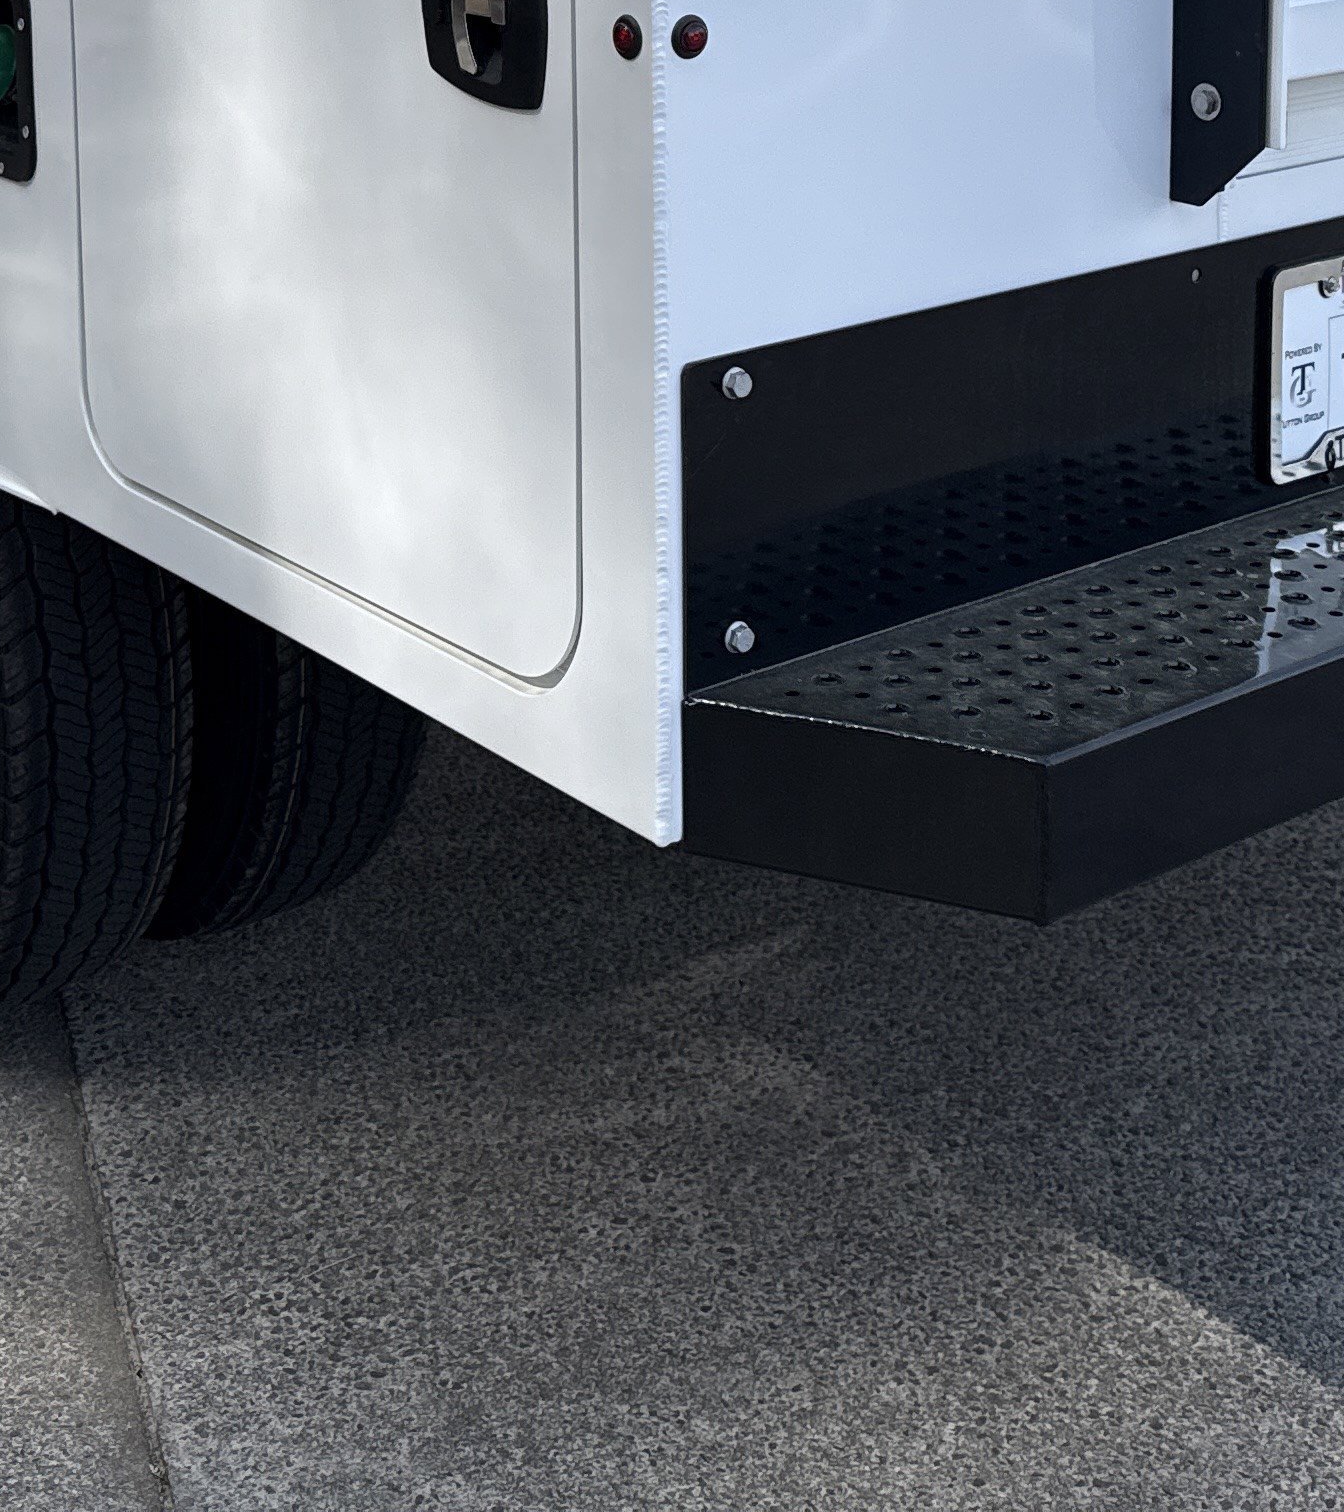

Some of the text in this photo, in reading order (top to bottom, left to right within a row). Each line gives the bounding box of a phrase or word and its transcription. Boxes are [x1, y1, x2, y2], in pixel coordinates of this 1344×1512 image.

[1284, 342, 1323, 360] POWERED BY
[1281, 410, 1325, 429] UTTON GROUP
